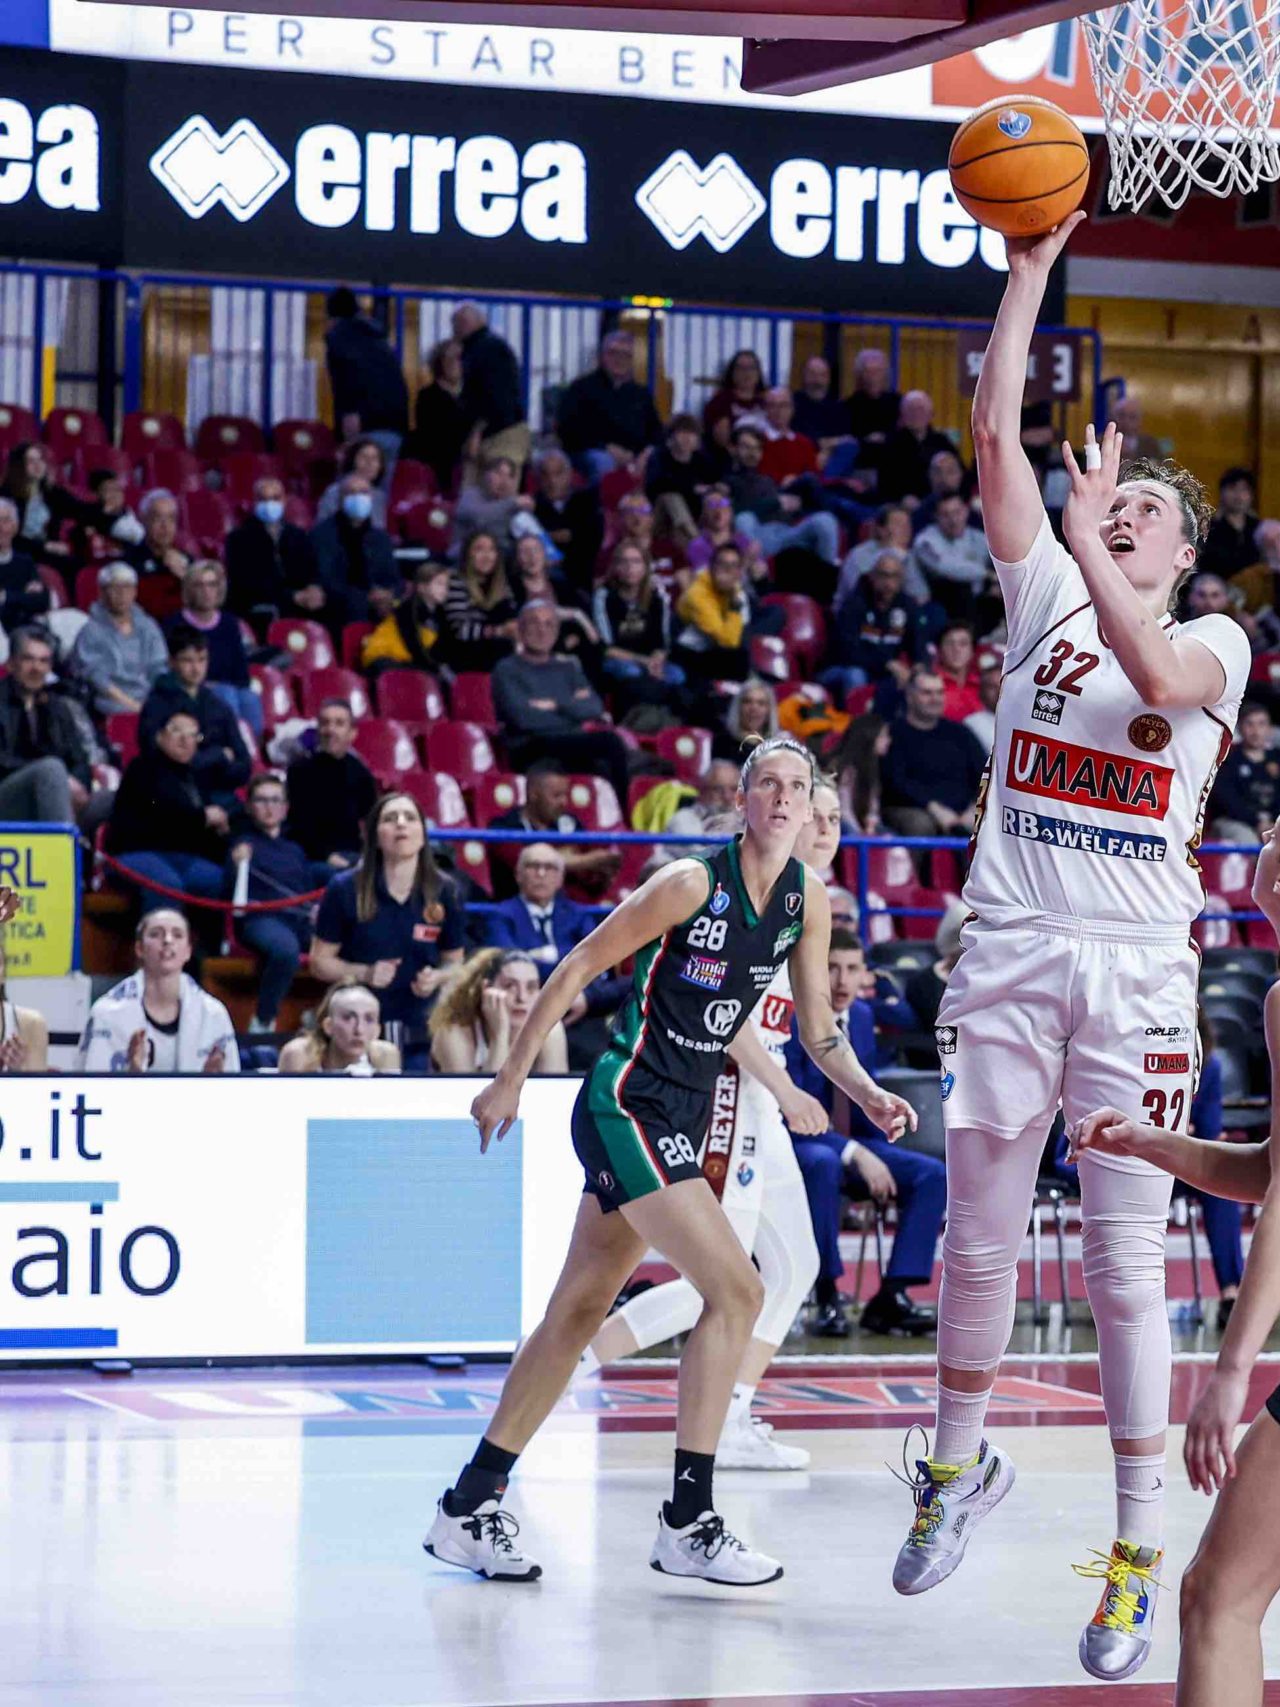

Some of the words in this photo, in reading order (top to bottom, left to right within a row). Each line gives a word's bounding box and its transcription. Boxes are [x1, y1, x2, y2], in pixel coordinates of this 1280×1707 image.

[167, 10, 305, 59] PER
[371, 26, 556, 79] STAR
[294, 122, 589, 245] errea
[1033, 639, 1100, 697] 32
[1032, 708, 1059, 725] errea
[1014, 738, 1159, 810] UMANA
[1002, 805, 1039, 840] RB
[1055, 819, 1104, 836] SISTEMA
[1057, 827, 1167, 861] WELFARE
[686, 915, 729, 951] 28
[1147, 1056, 1188, 1072] UMANA
[0, 1091, 102, 1161] .it
[708, 1073, 738, 1155] REYER
[1141, 1088, 1185, 1132] 32
[657, 1132, 696, 1168] 28
[11, 1200, 181, 1298] aio
